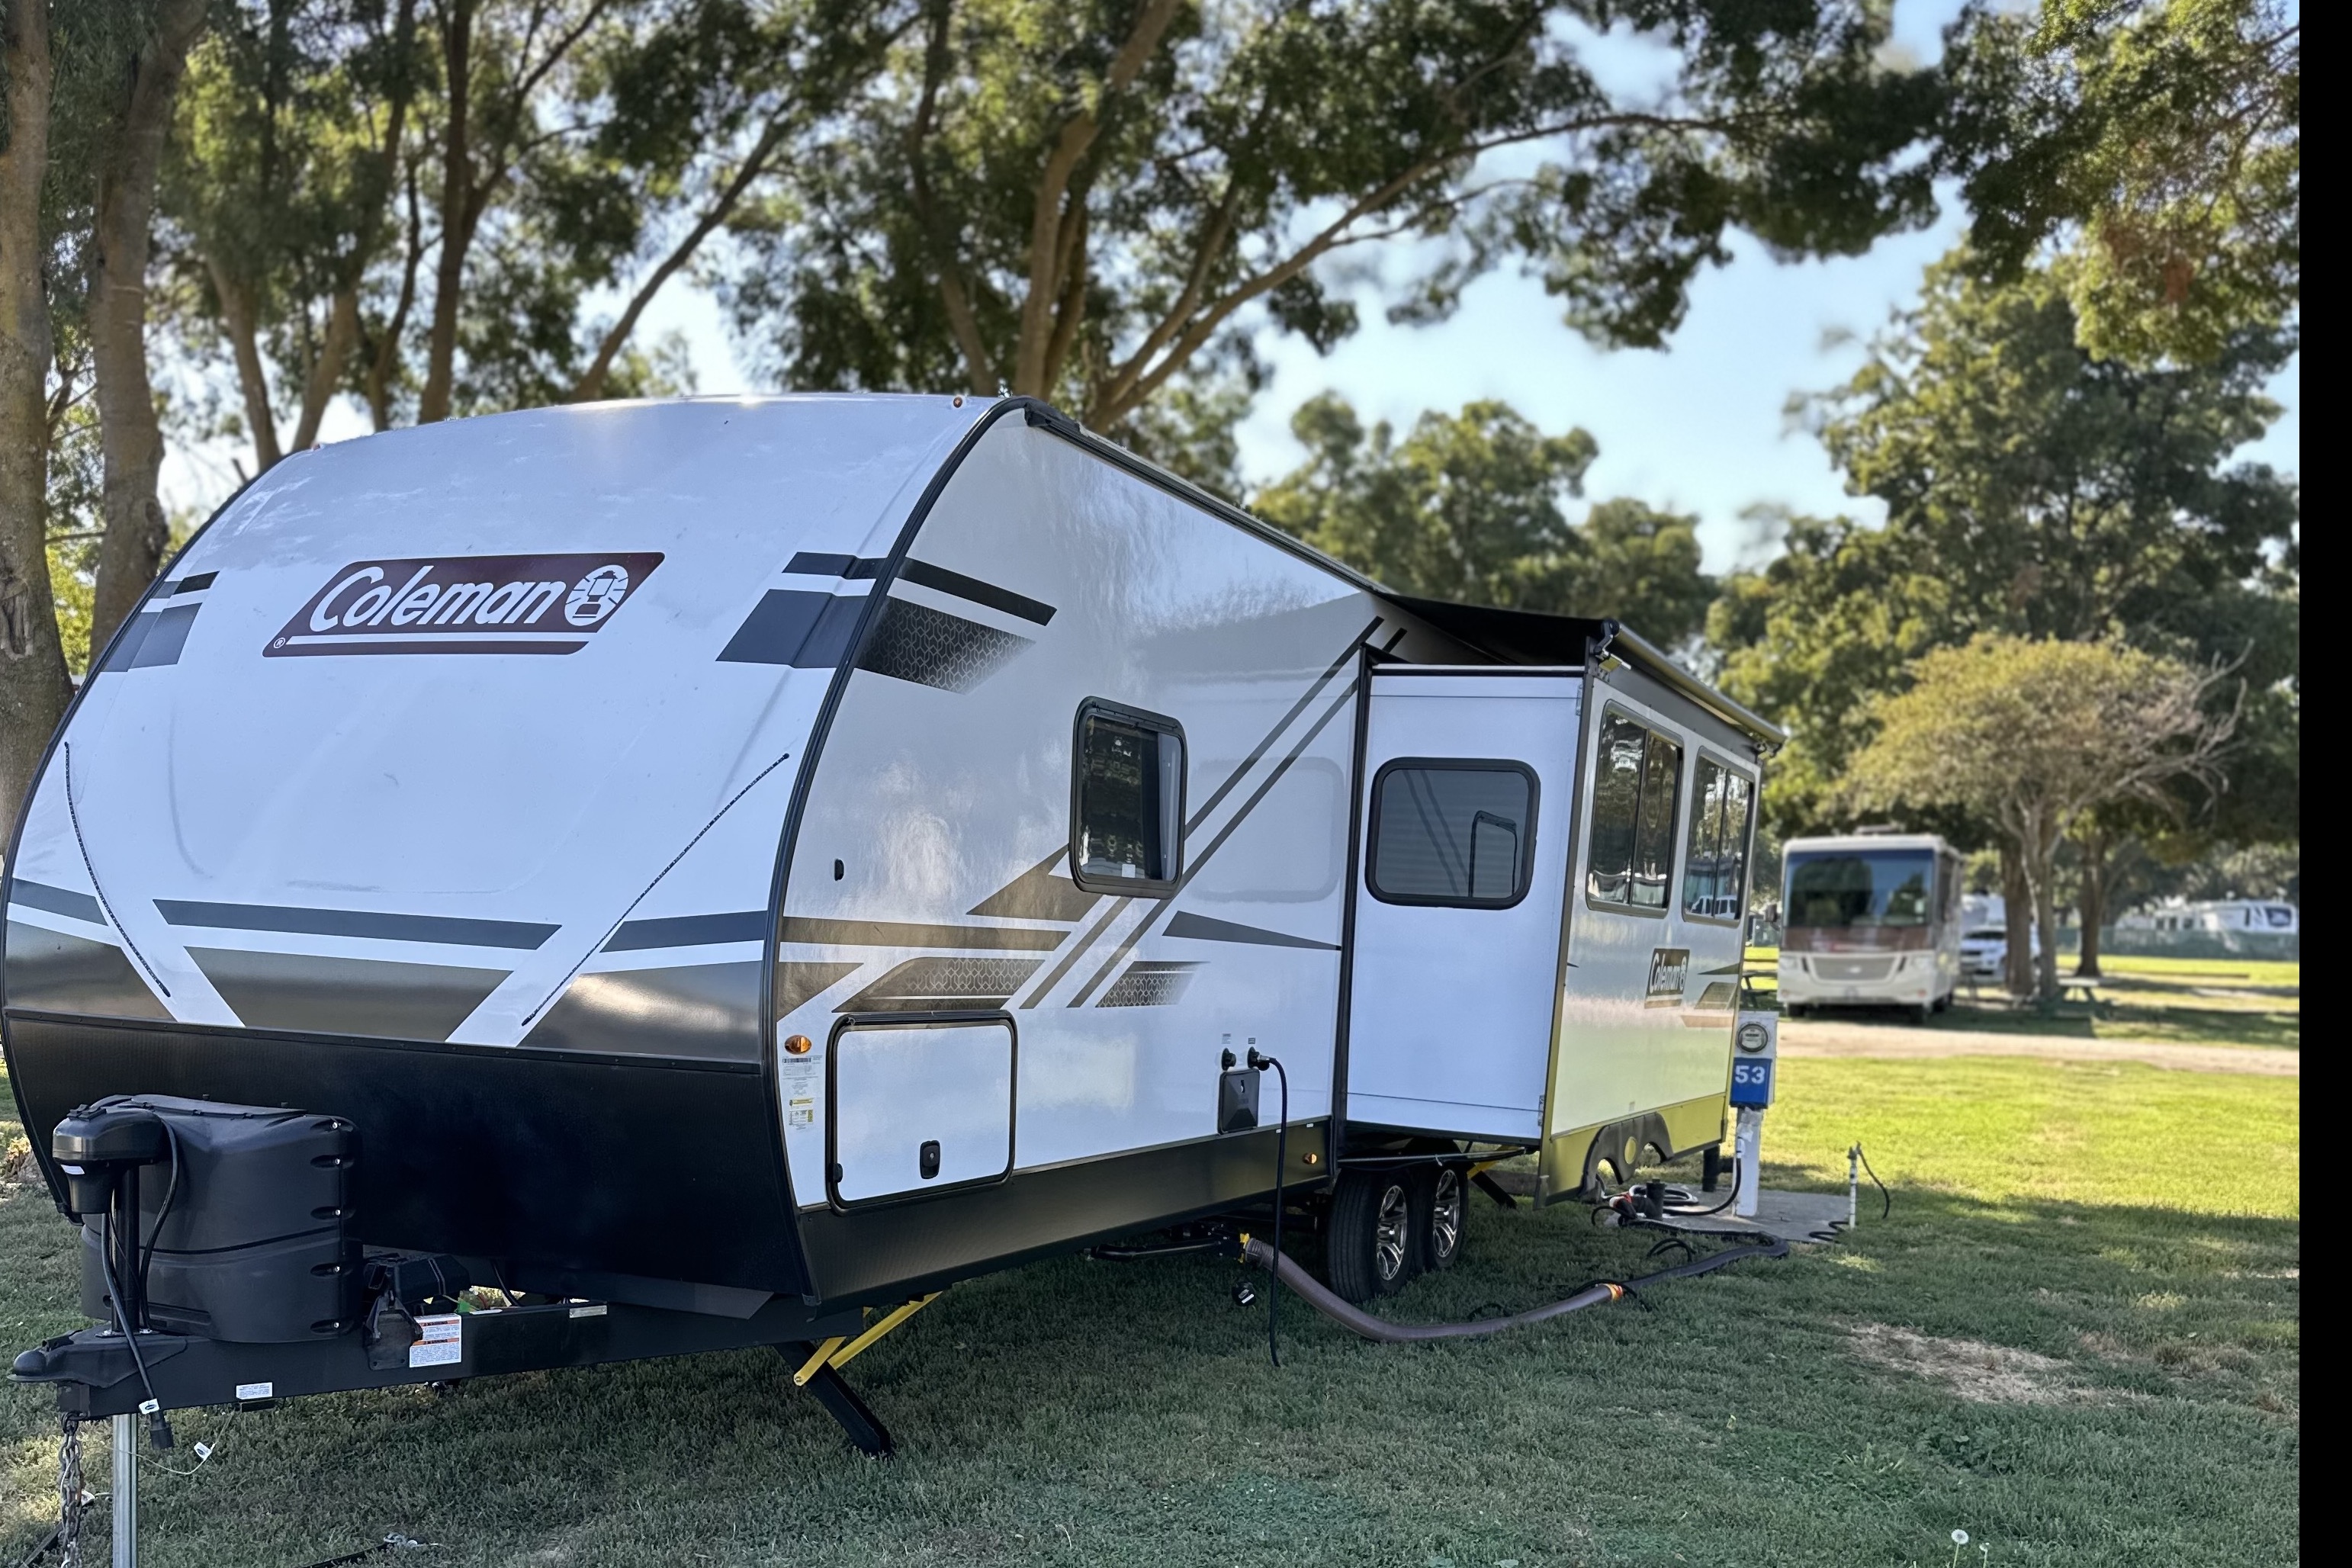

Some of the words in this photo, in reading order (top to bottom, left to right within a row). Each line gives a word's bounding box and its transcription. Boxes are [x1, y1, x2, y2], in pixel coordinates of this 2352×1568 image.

[309, 565, 567, 632] Coleman
[1650, 953, 1681, 994] Coleman
[1735, 1065, 1766, 1084] 53
